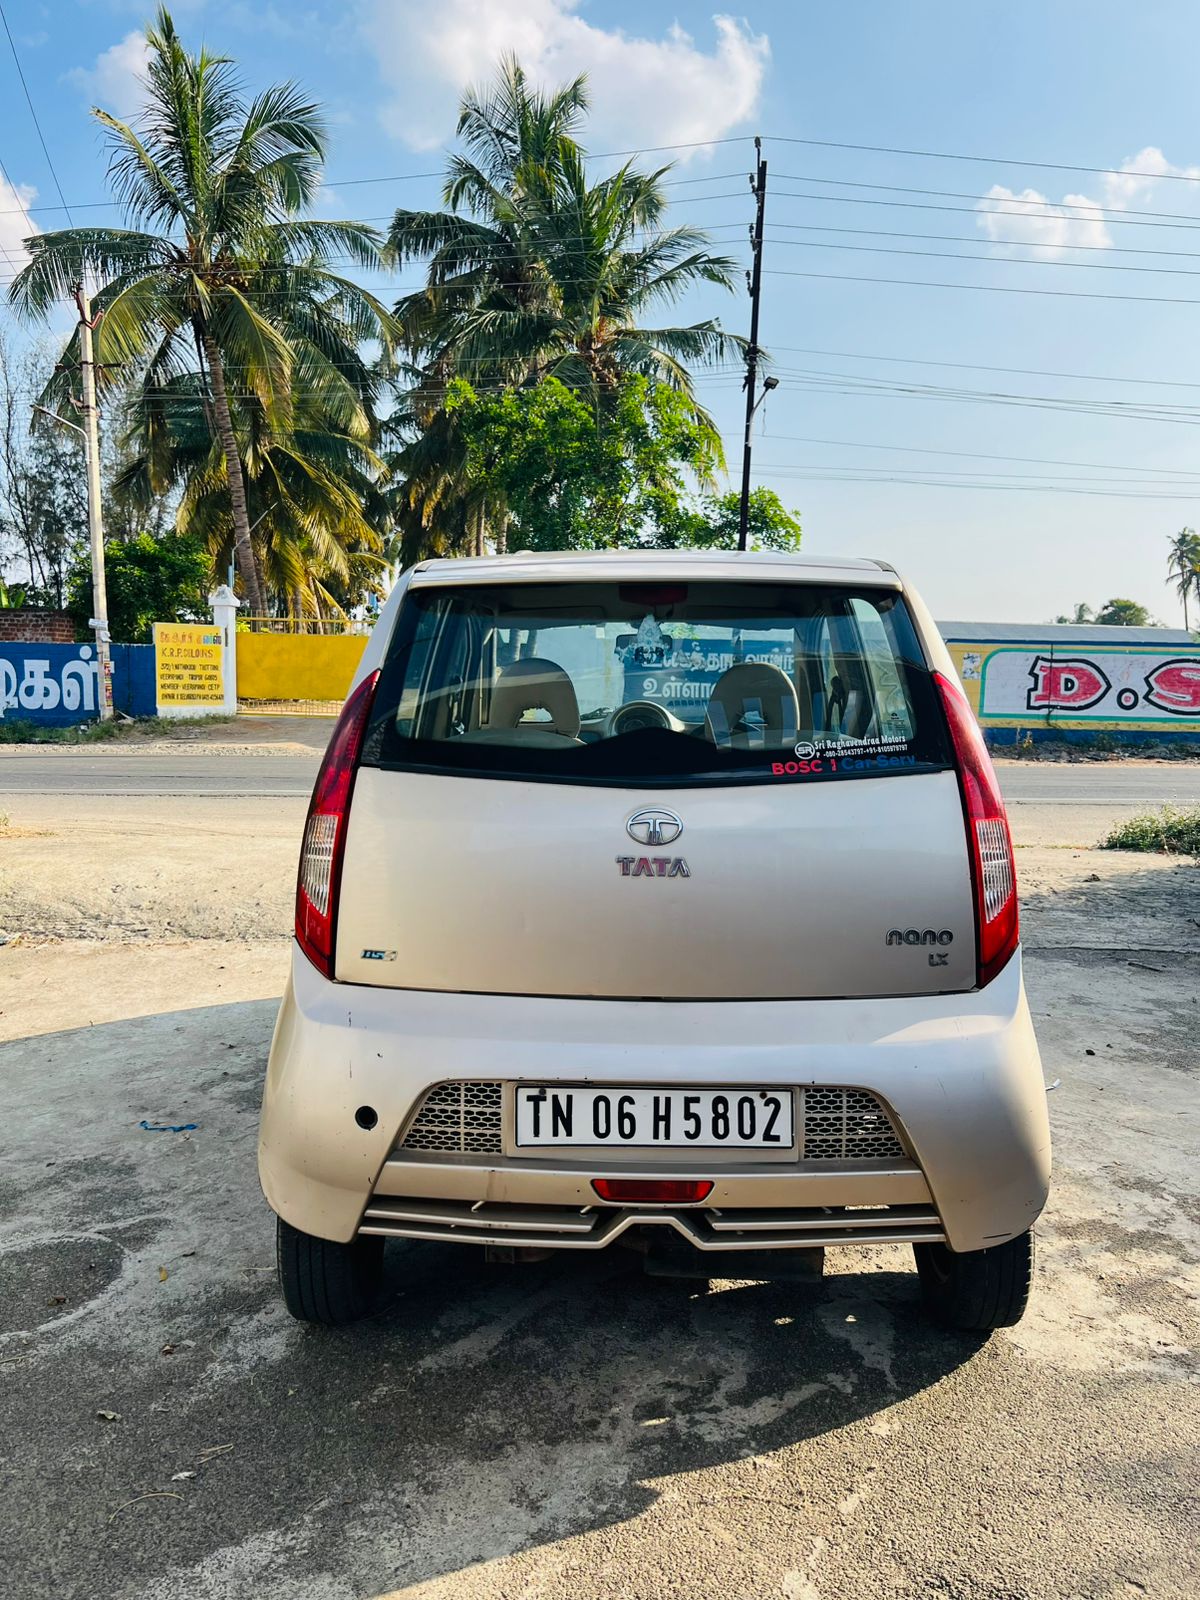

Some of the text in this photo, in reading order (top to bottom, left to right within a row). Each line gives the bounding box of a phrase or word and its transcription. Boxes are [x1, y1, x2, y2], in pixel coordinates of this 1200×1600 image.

[814, 740, 826, 750] Sri
[881, 735, 906, 744] Motors
[841, 757, 873, 770] Car
[616, 856, 691, 878] TATA
[886, 927, 954, 946] nano
[928, 952, 949, 967] LX
[526, 1093, 573, 1138] TN
[592, 1094, 637, 1140] 06
